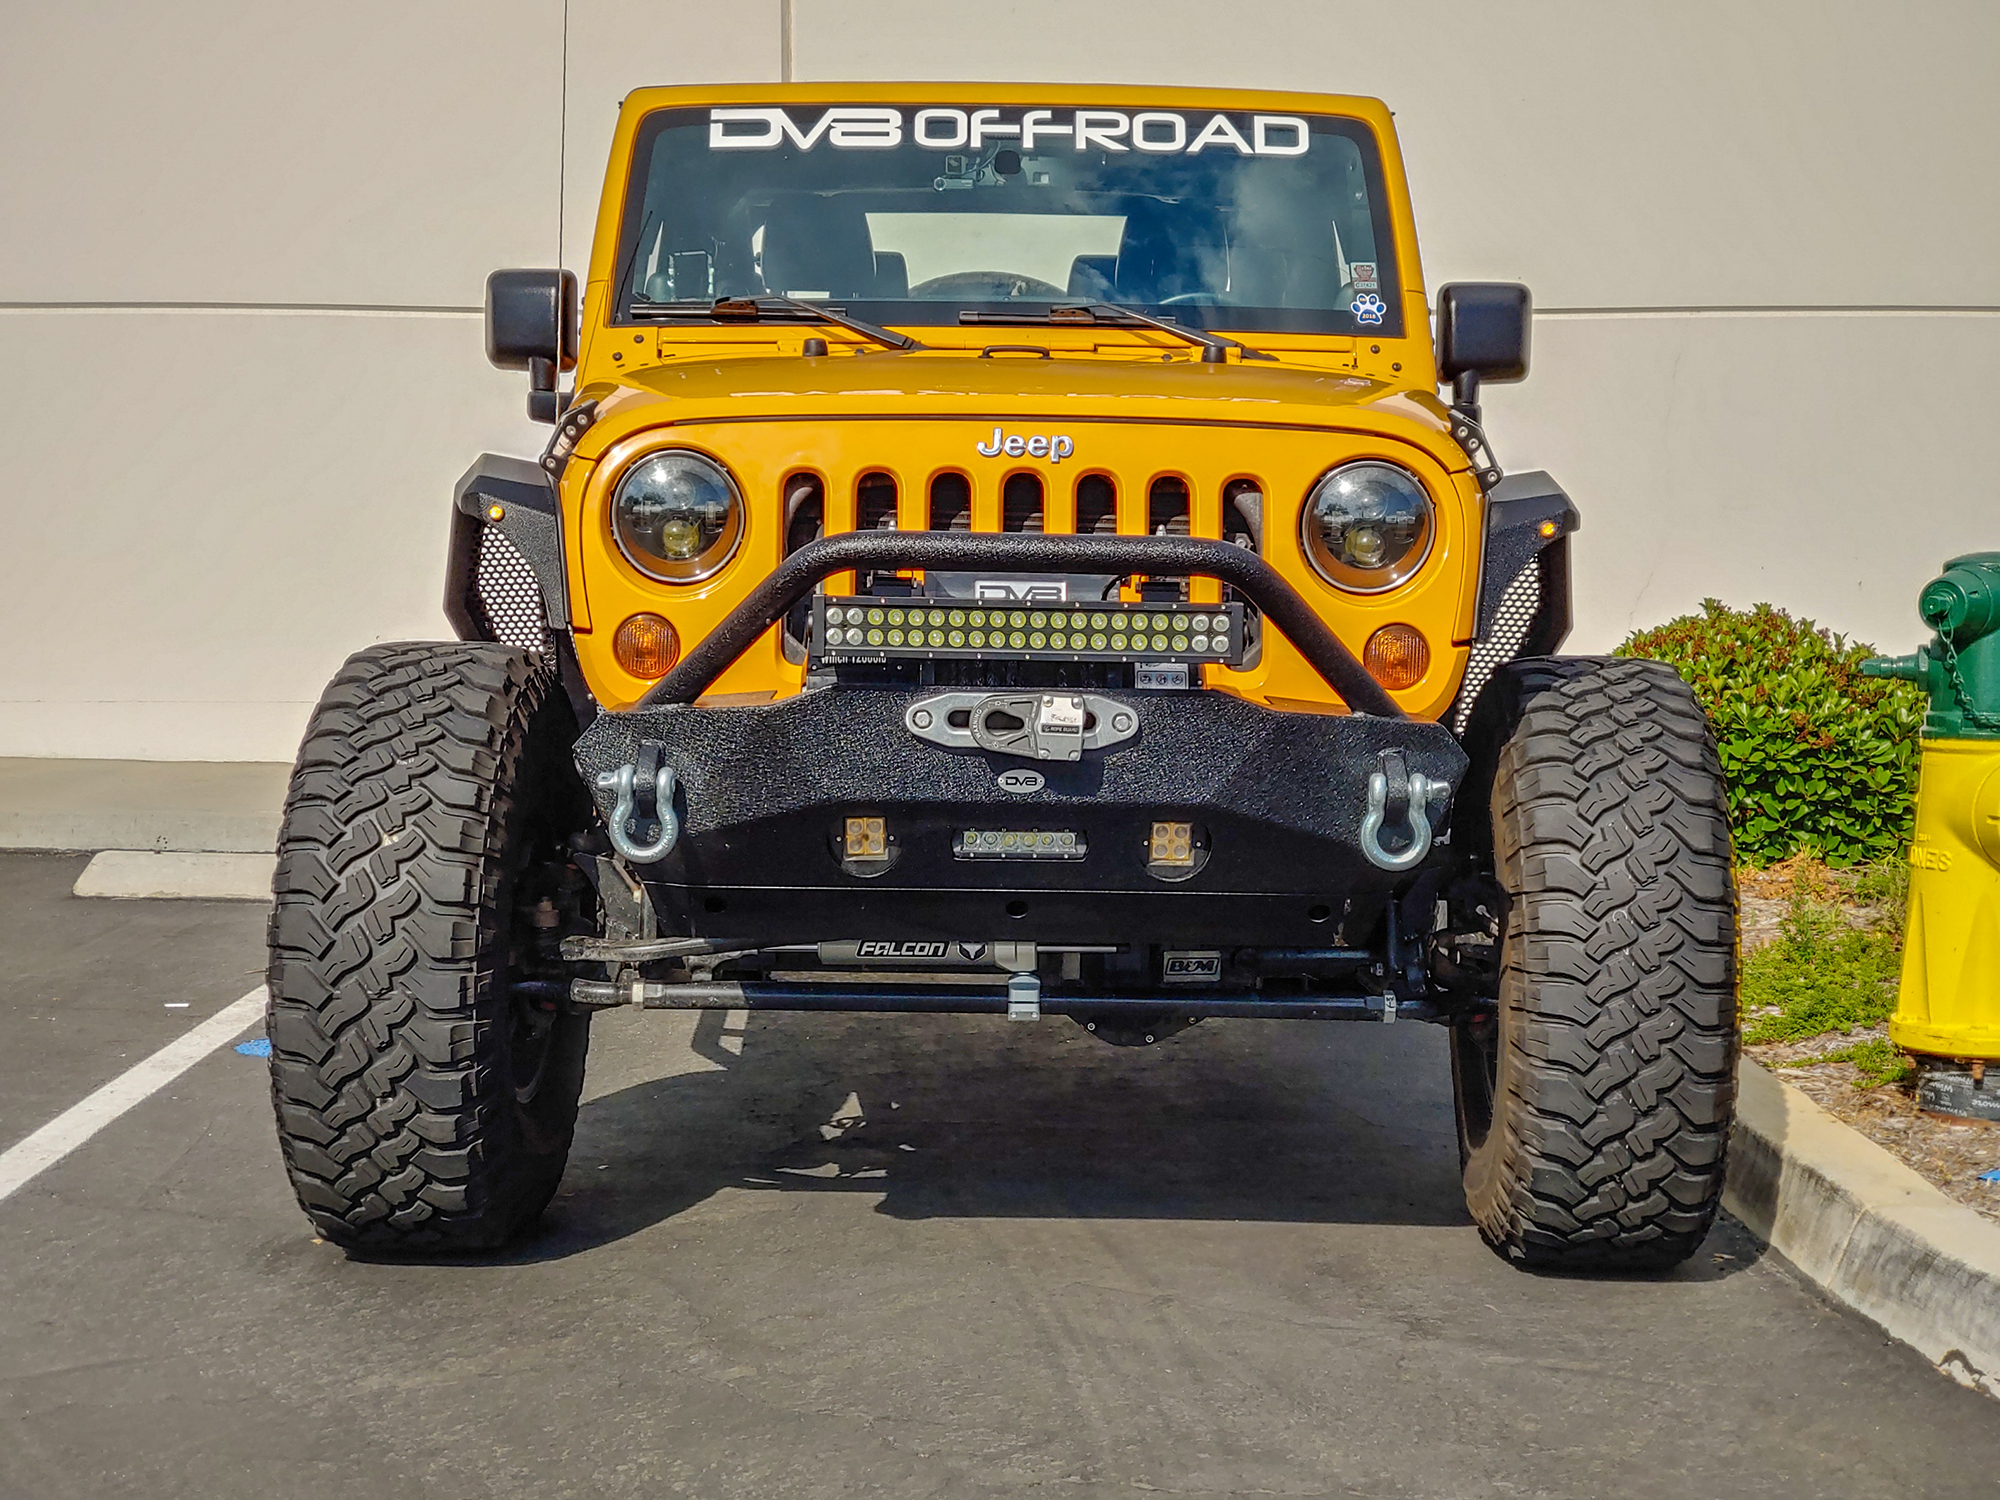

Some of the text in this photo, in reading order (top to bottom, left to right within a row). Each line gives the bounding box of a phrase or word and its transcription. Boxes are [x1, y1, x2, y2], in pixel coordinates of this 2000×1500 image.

[709, 108, 902, 150] DV8
[976, 427, 1074, 464] Jeep
[972, 708, 983, 739] WARNING
[1005, 776, 1038, 786] DV8
[860, 942, 945, 956] FALCON
[1169, 960, 1215, 972] B&M
